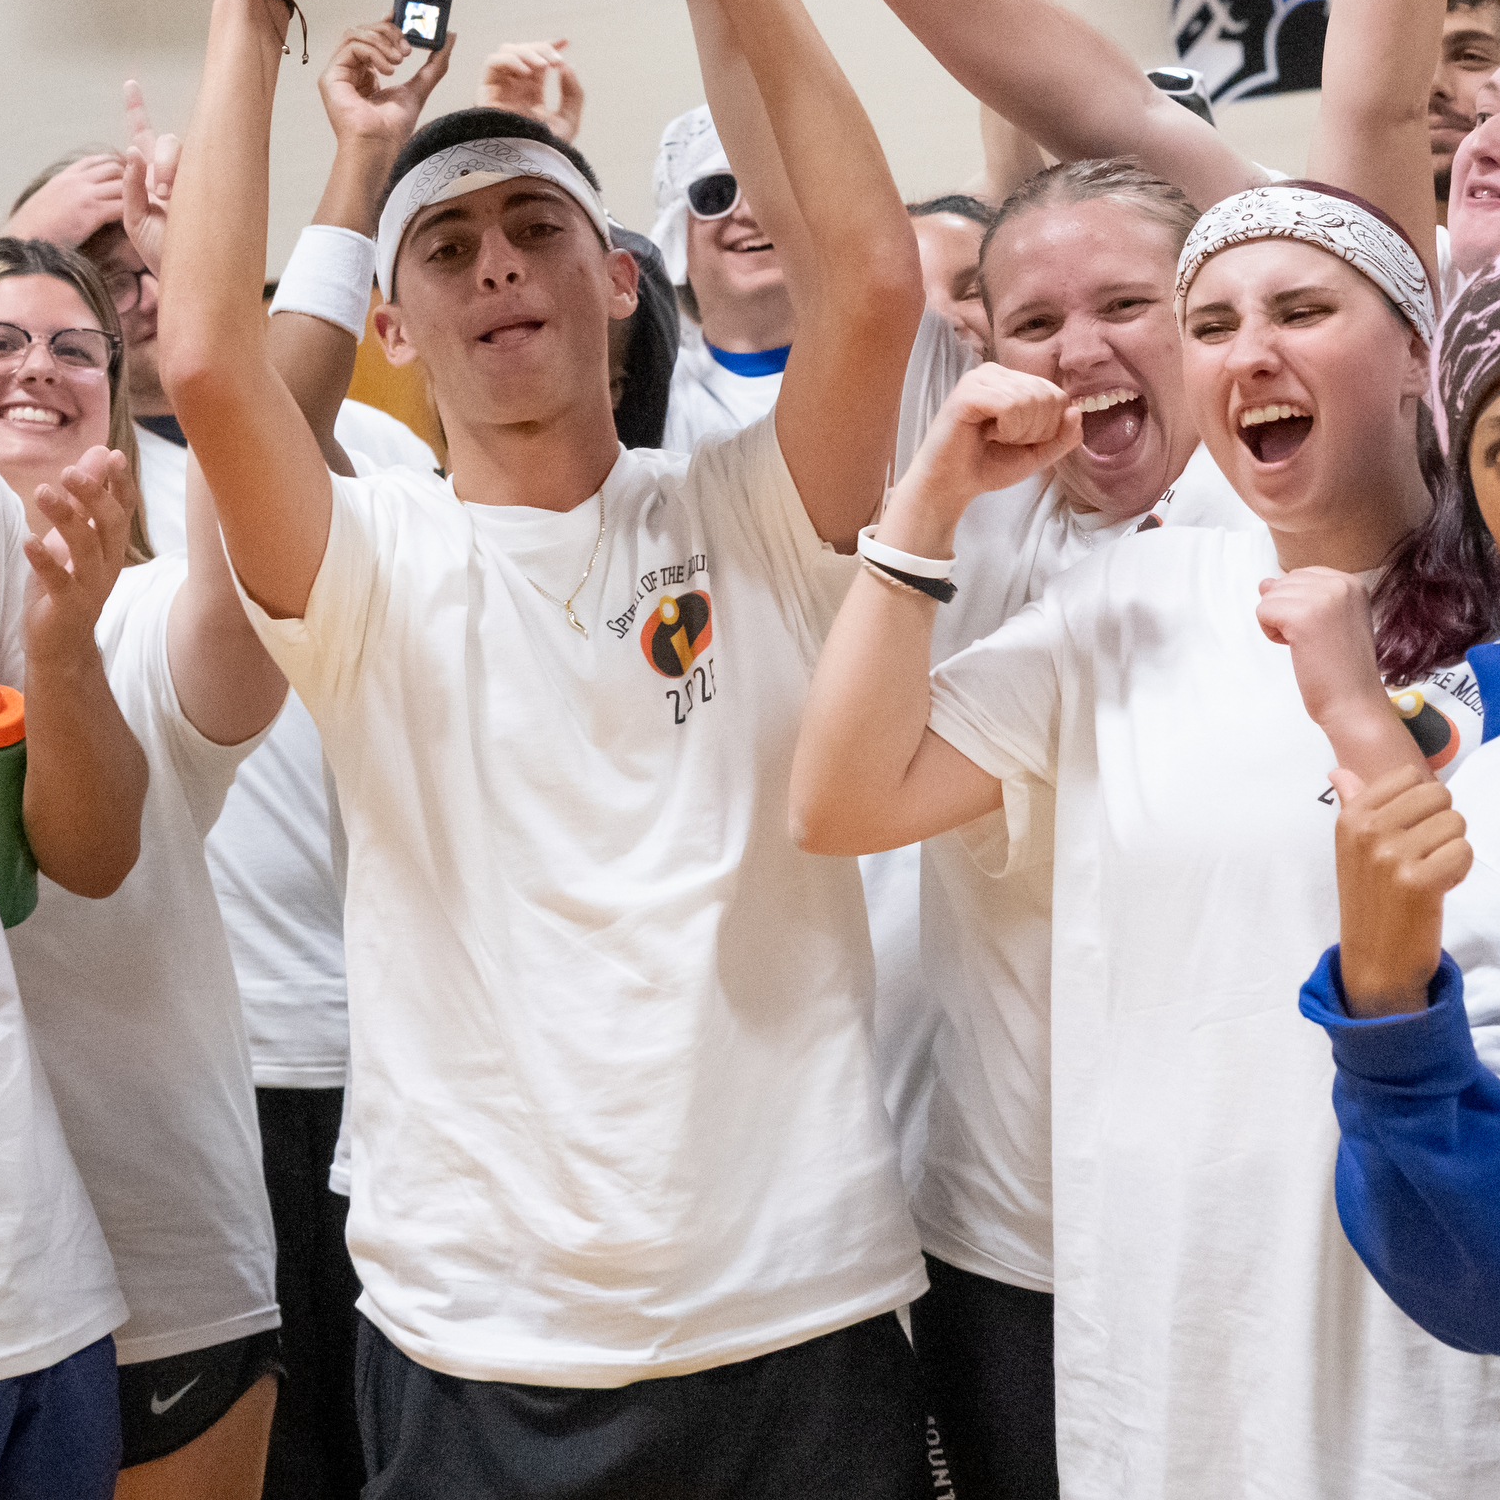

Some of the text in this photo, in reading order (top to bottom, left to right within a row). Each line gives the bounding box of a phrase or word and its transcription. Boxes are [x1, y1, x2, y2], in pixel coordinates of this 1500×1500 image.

[640, 571, 657, 593] OF
[660, 566, 684, 586] THE
[1450, 674, 1484, 716] MOU
[925, 1415, 956, 1500] OUNT
